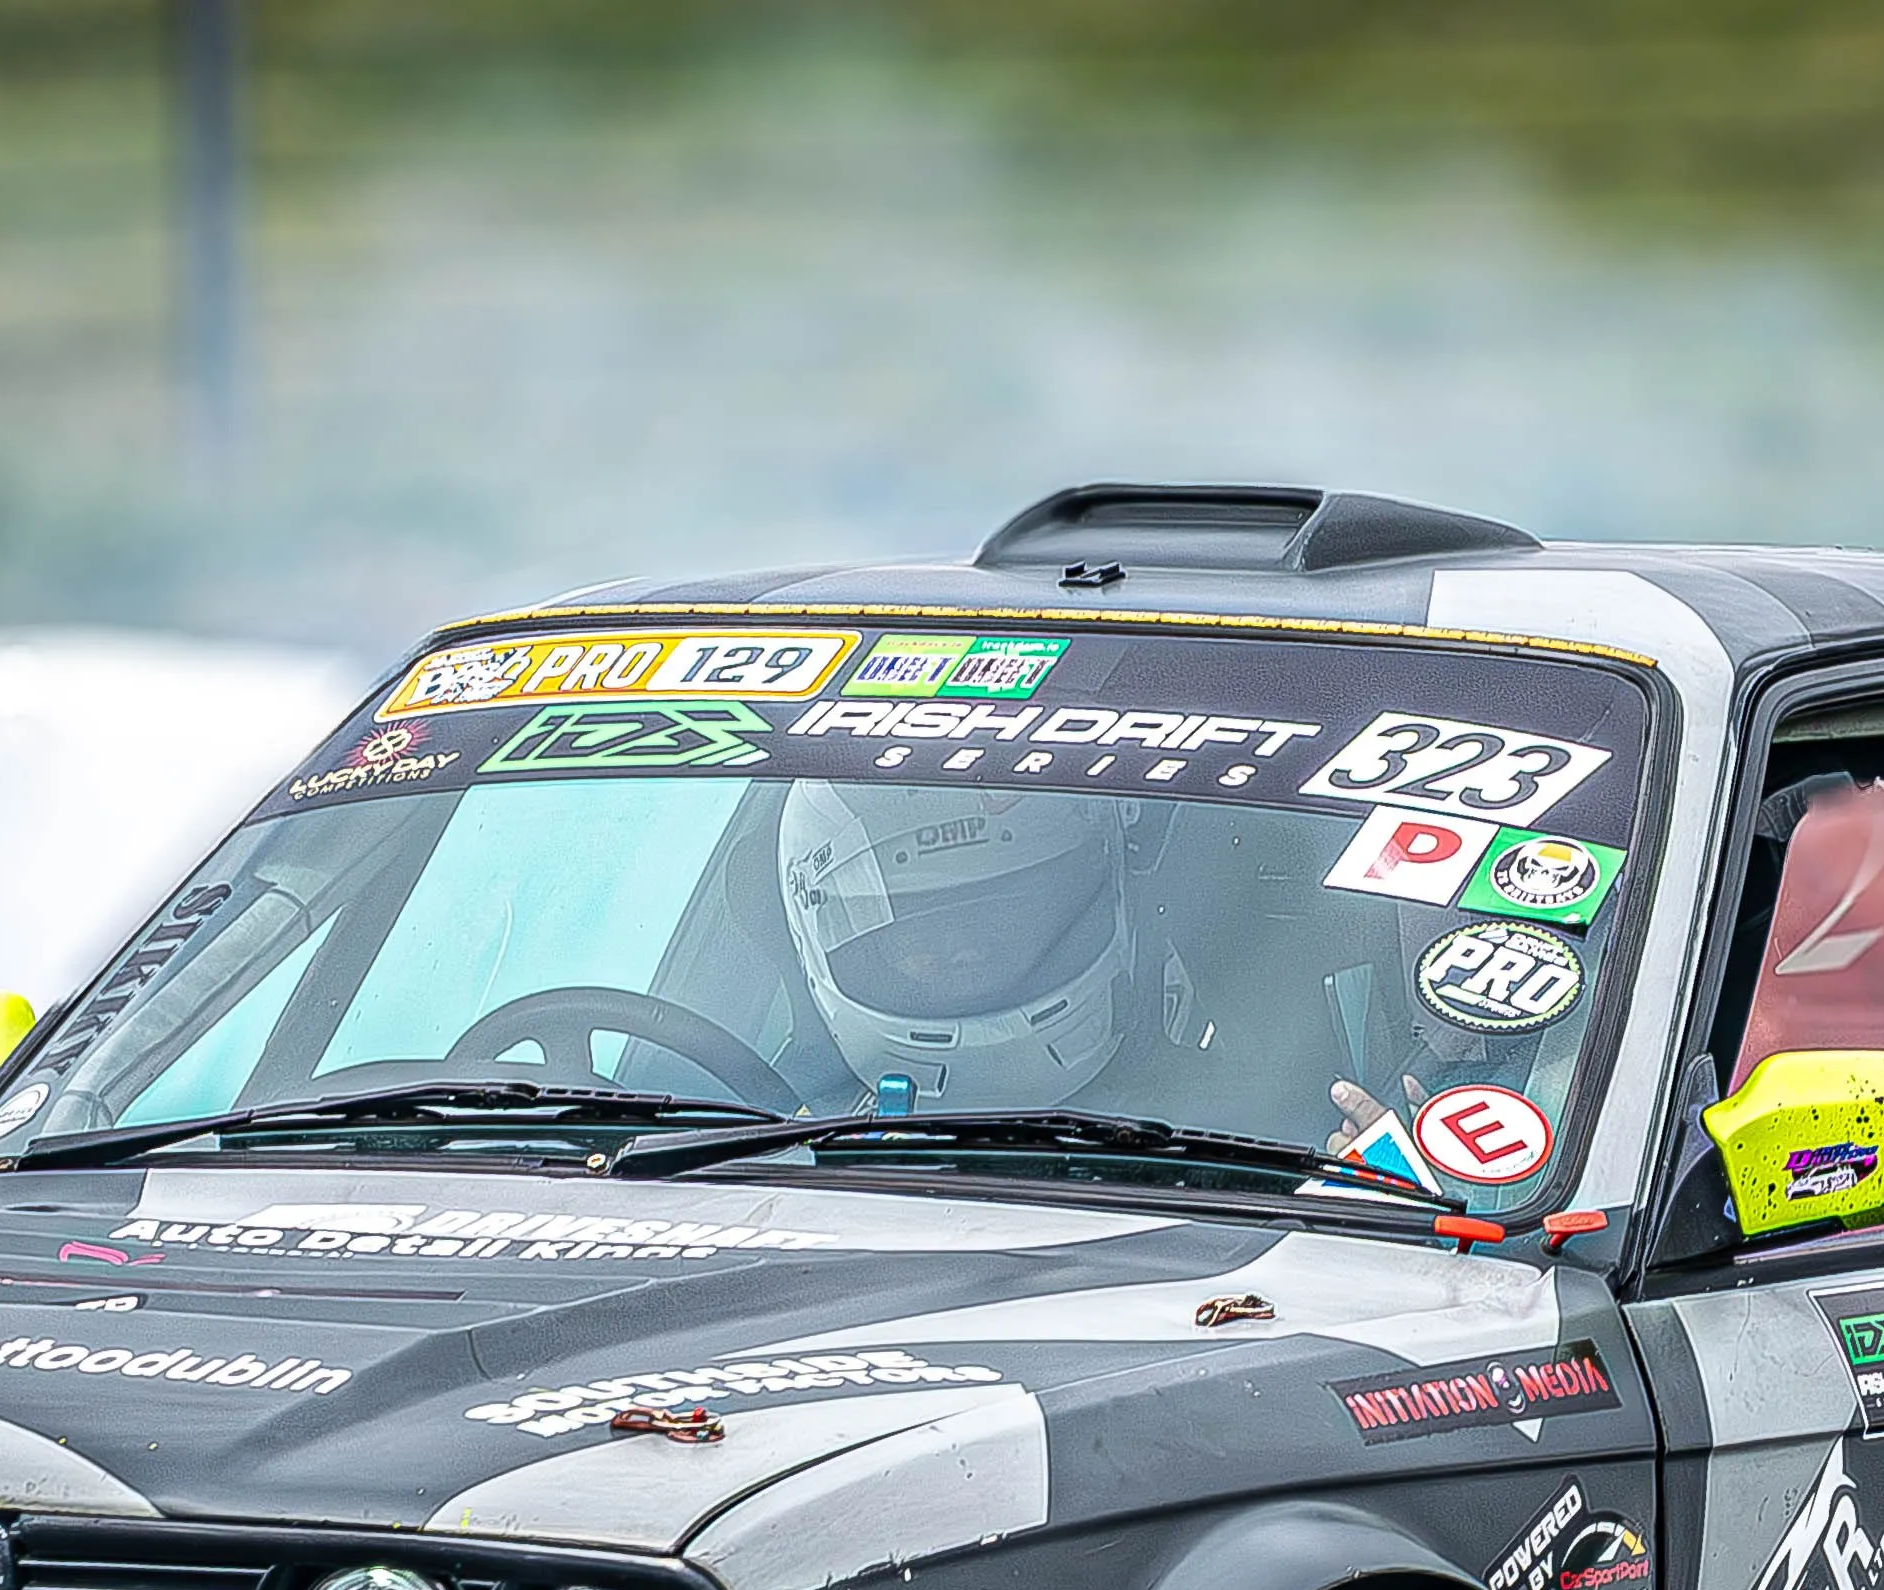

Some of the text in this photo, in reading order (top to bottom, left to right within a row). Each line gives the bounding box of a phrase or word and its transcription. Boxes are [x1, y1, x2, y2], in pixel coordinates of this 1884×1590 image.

[523, 642, 663, 693] PRO
[680, 645, 812, 685] 129
[788, 700, 1322, 757] IRISH DRIFT
[289, 750, 461, 795] LUCKY DAY
[293, 768, 432, 801] COMPETITIONS
[874, 746, 1257, 788] SERIES
[1328, 723, 1571, 809] 323
[1364, 821, 1463, 880] P
[1420, 934, 1581, 1015] PRO
[1440, 1101, 1528, 1164] E
[109, 1219, 285, 1247] Auto
[297, 1228, 513, 1259] Detail
[1345, 1357, 1609, 1430] INITIATION MEDIA
